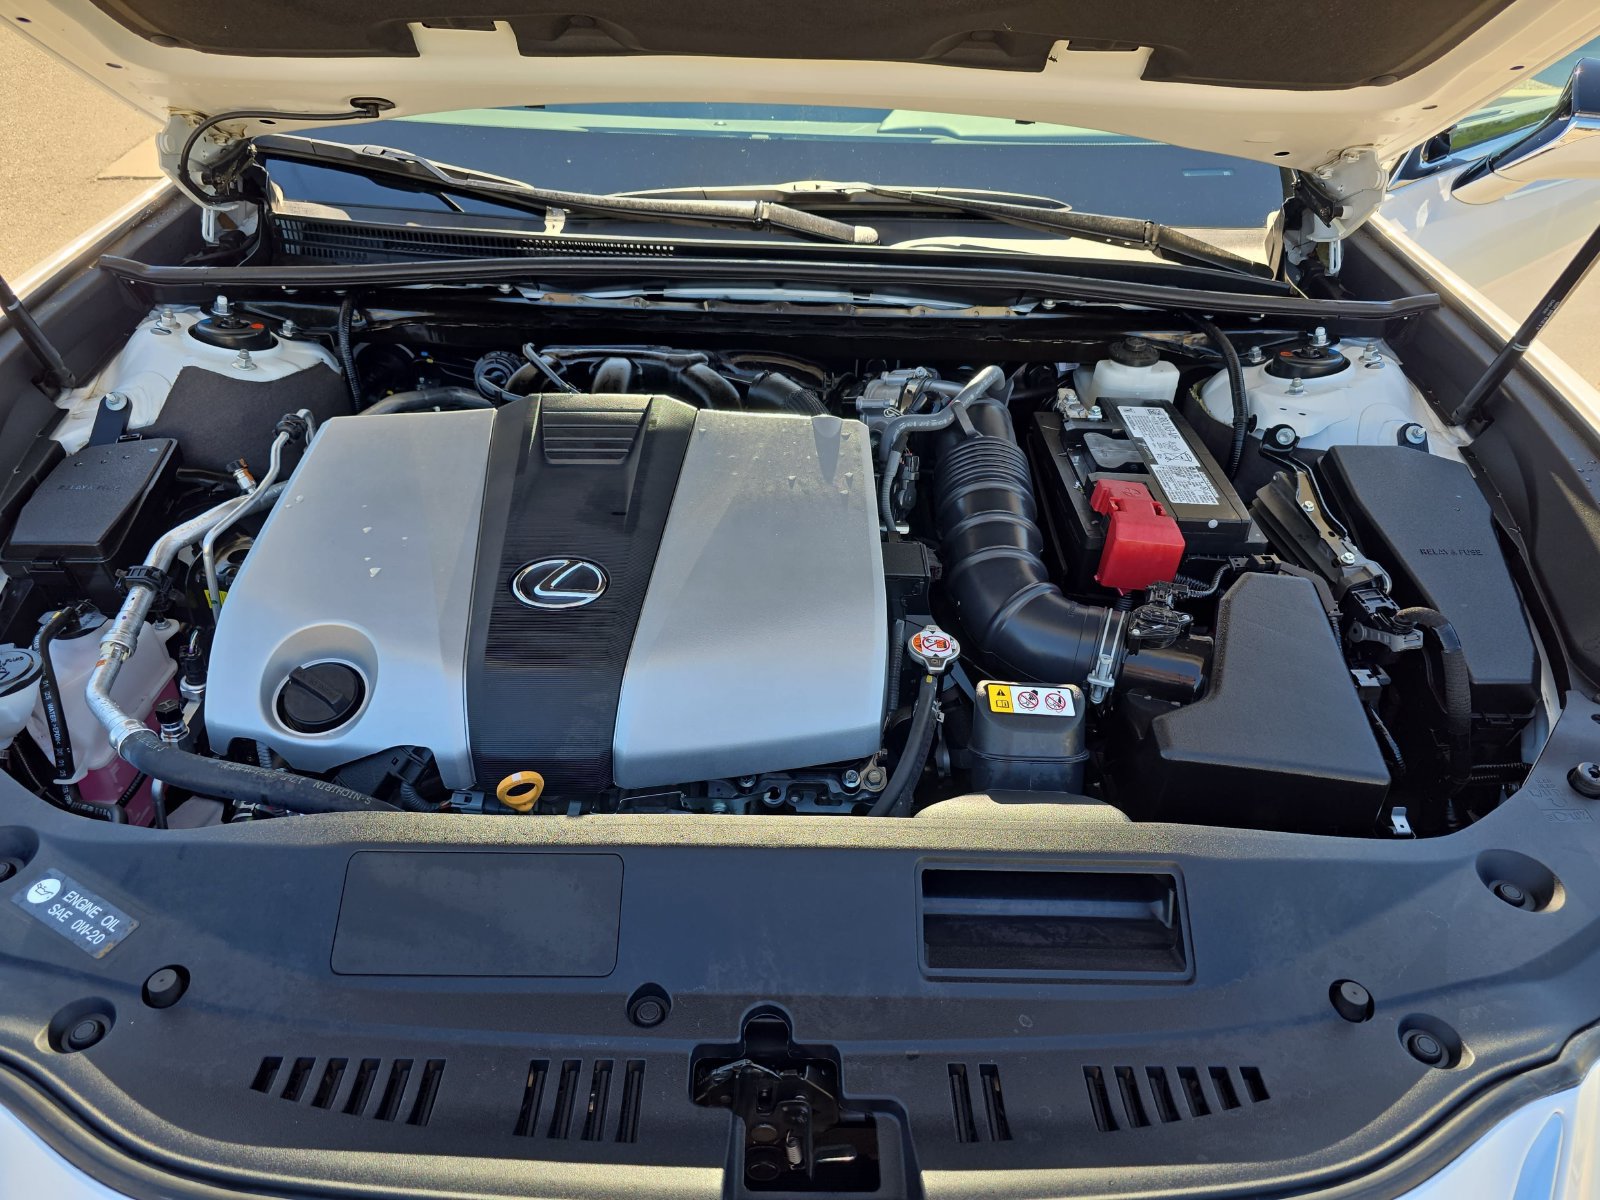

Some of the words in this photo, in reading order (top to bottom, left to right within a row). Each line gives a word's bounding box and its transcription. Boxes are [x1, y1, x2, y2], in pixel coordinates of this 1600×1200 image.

[1419, 548, 1449, 556] RELAY
[47, 702, 56, 723] WATER
[47, 903, 73, 923] SAE
[70, 919, 106, 945] 0W-20
[62, 890, 103, 919] ENGINE
[100, 915, 121, 933] OIL
